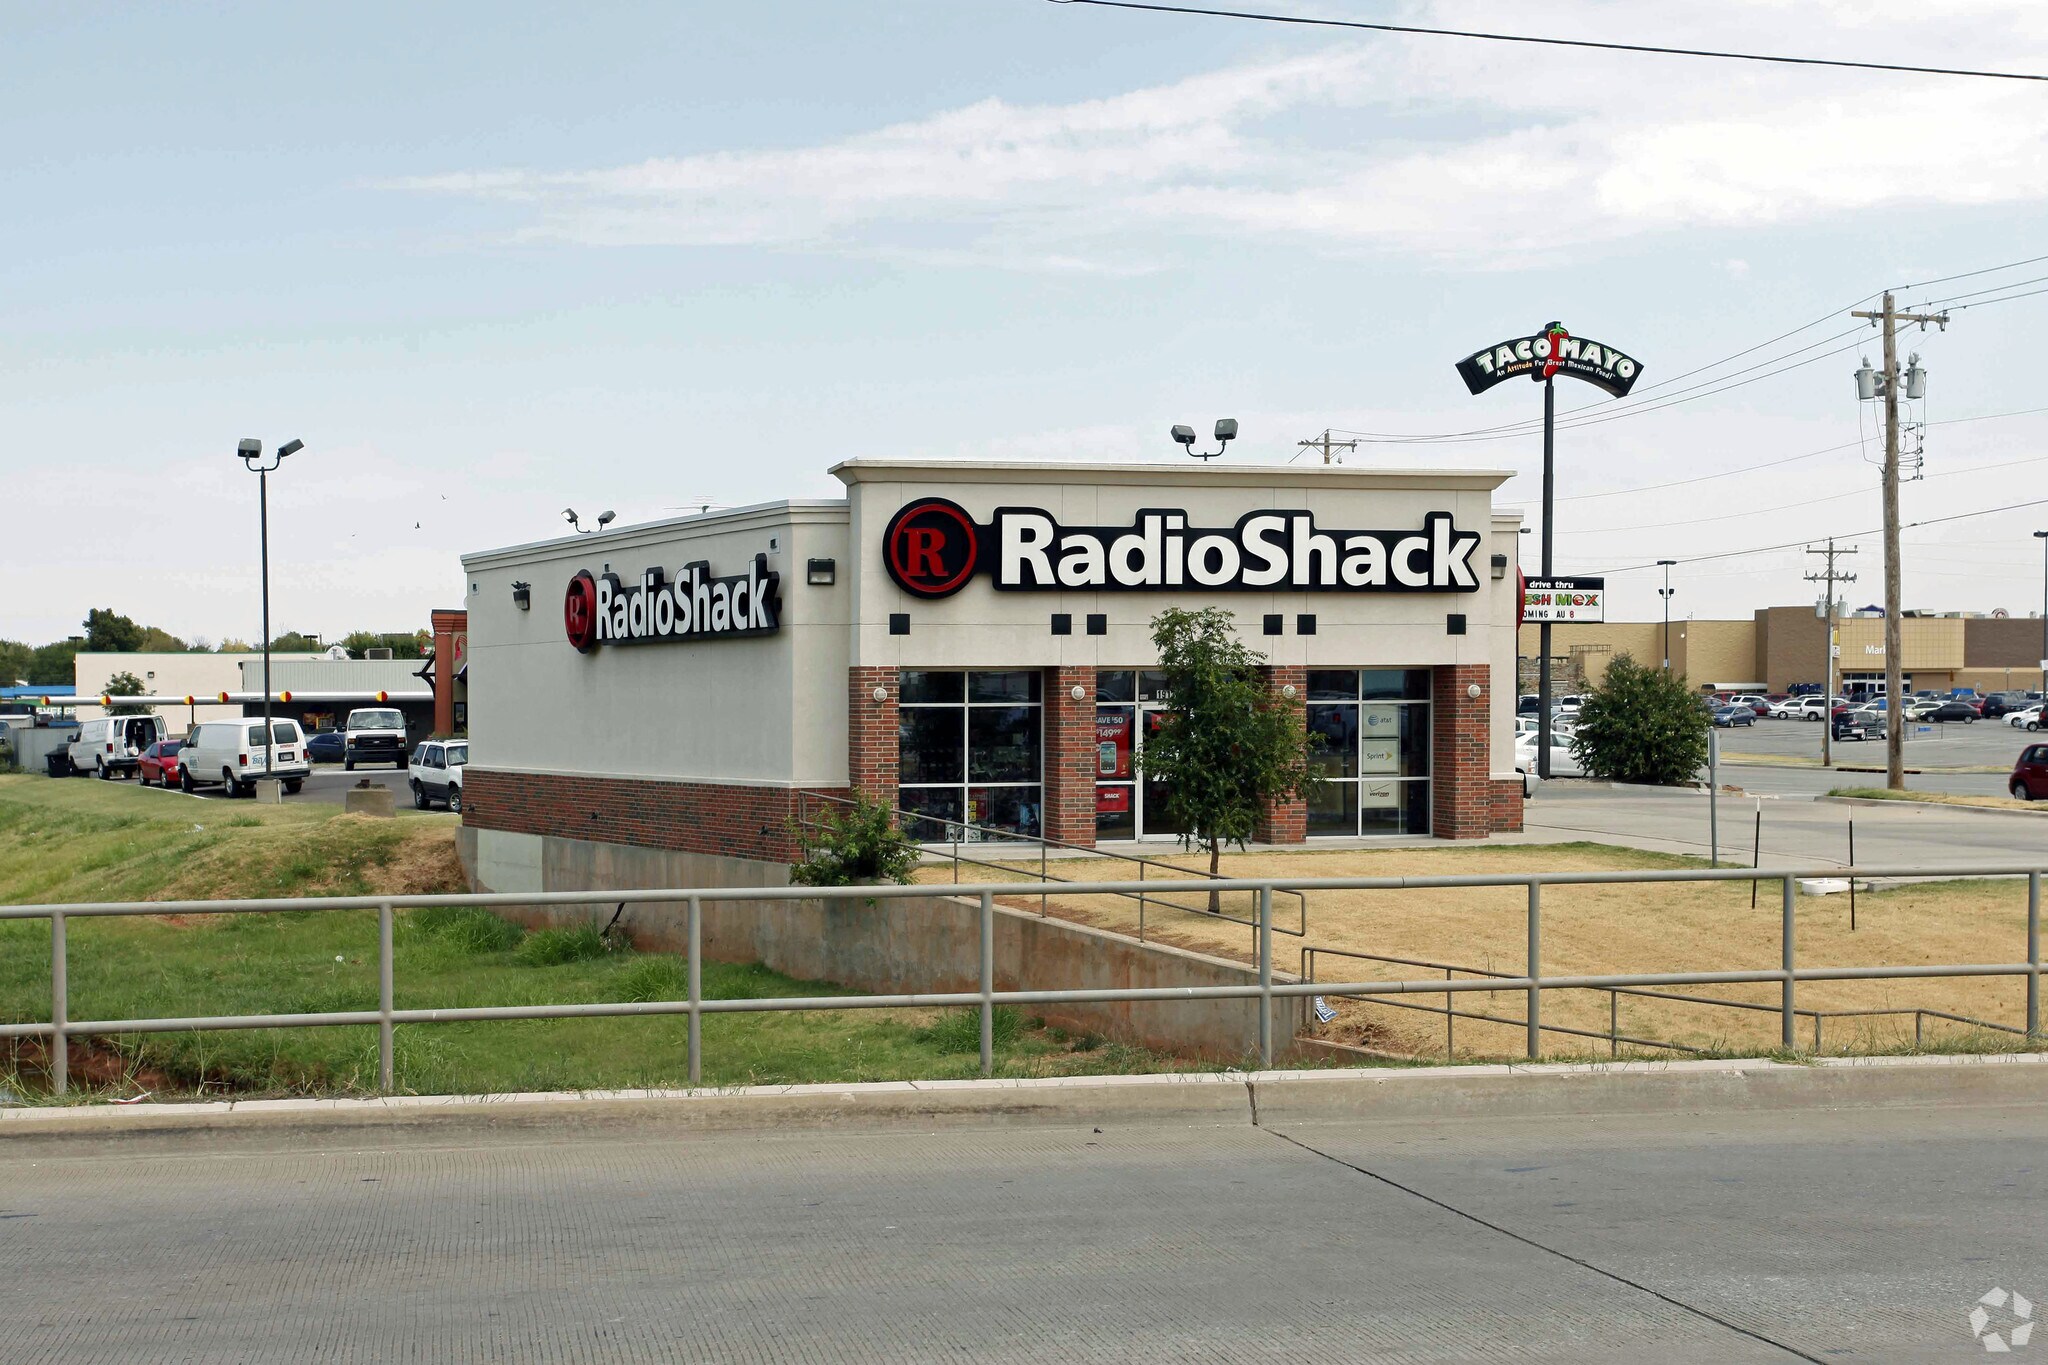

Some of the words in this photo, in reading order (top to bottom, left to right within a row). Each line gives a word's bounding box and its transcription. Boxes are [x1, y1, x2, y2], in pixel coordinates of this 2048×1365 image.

[1475, 338, 1551, 375] TACO
[1557, 337, 1635, 379] MAYO
[1496, 369, 1506, 378] An
[1506, 362, 1533, 374] Attitude
[1547, 358, 1565, 367] Great
[1567, 359, 1594, 373] Mexican
[1001, 514, 1478, 587] RadioShack
[1529, 581, 1552, 589] drive
[1554, 581, 1574, 589] thru
[596, 559, 768, 640] RadioShack
[1556, 610, 1566, 618] AU
[1569, 610, 1575, 618] 8
[1366, 752, 1385, 760] Sprint
